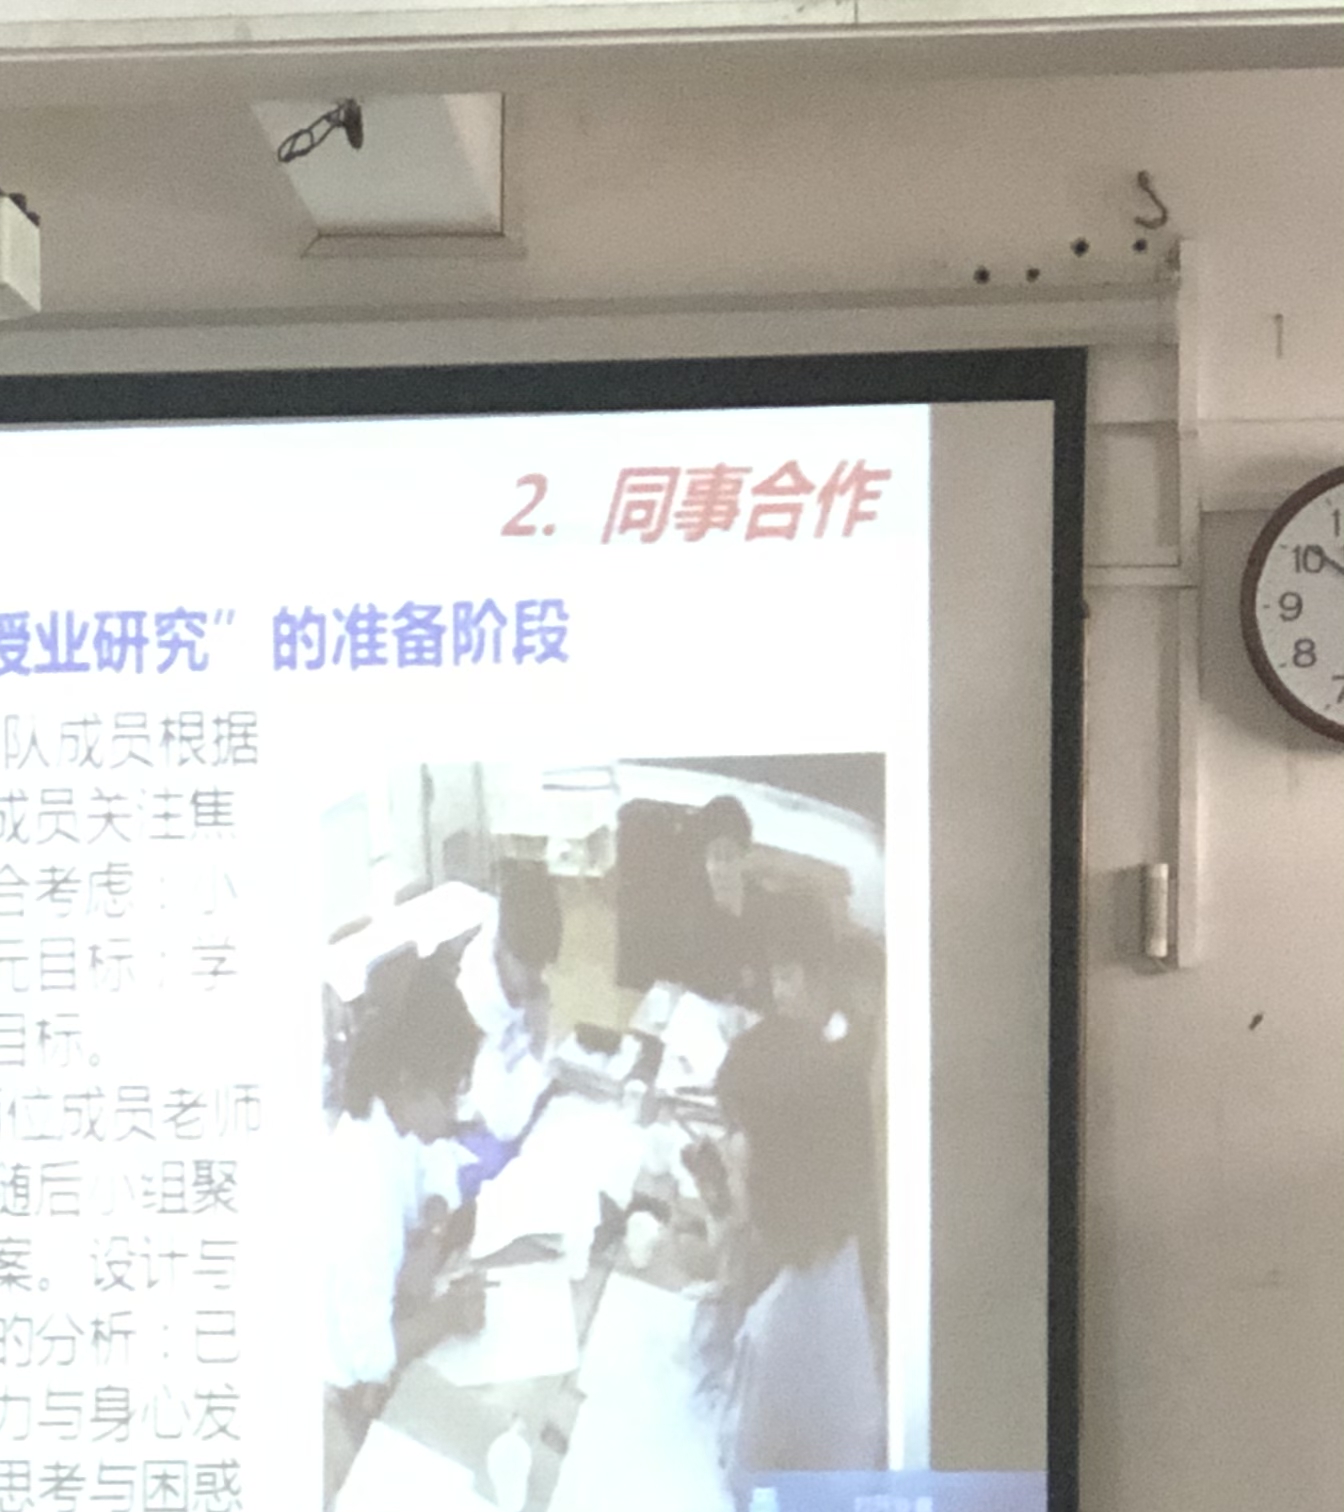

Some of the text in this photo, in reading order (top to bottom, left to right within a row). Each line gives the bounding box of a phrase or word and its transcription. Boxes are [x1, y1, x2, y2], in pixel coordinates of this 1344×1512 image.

[500, 459, 893, 544] 2. 同事合作
[1293, 544, 1327, 574] 10
[1278, 591, 1303, 622] 9
[1292, 638, 1317, 668] 8
